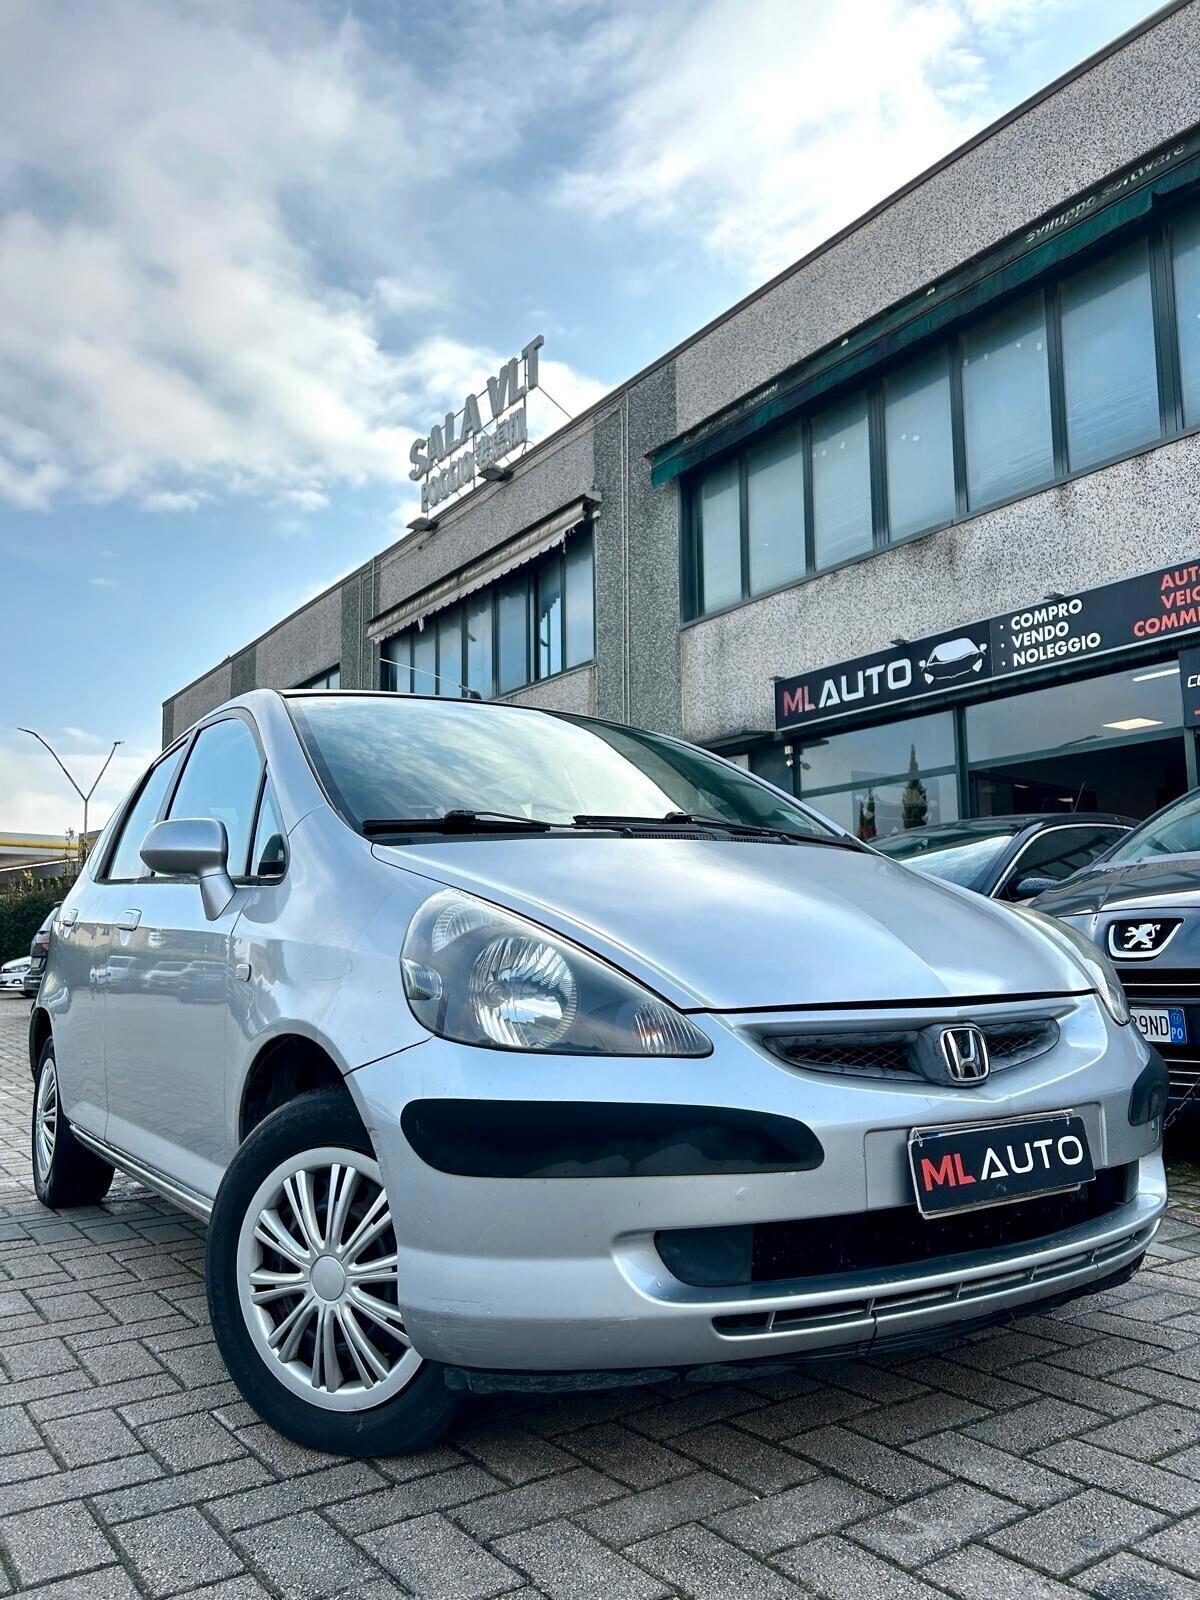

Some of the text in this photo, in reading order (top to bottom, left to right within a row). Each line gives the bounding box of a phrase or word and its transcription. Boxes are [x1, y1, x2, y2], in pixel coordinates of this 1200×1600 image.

[409, 334, 545, 482] SALA VLT
[1160, 566, 1200, 591] AUT
[1010, 598, 1083, 631] COMPRO
[1133, 607, 1200, 637] COMM
[1011, 621, 1070, 649] VENDO
[1013, 632, 1101, 667] NOLEGGIO
